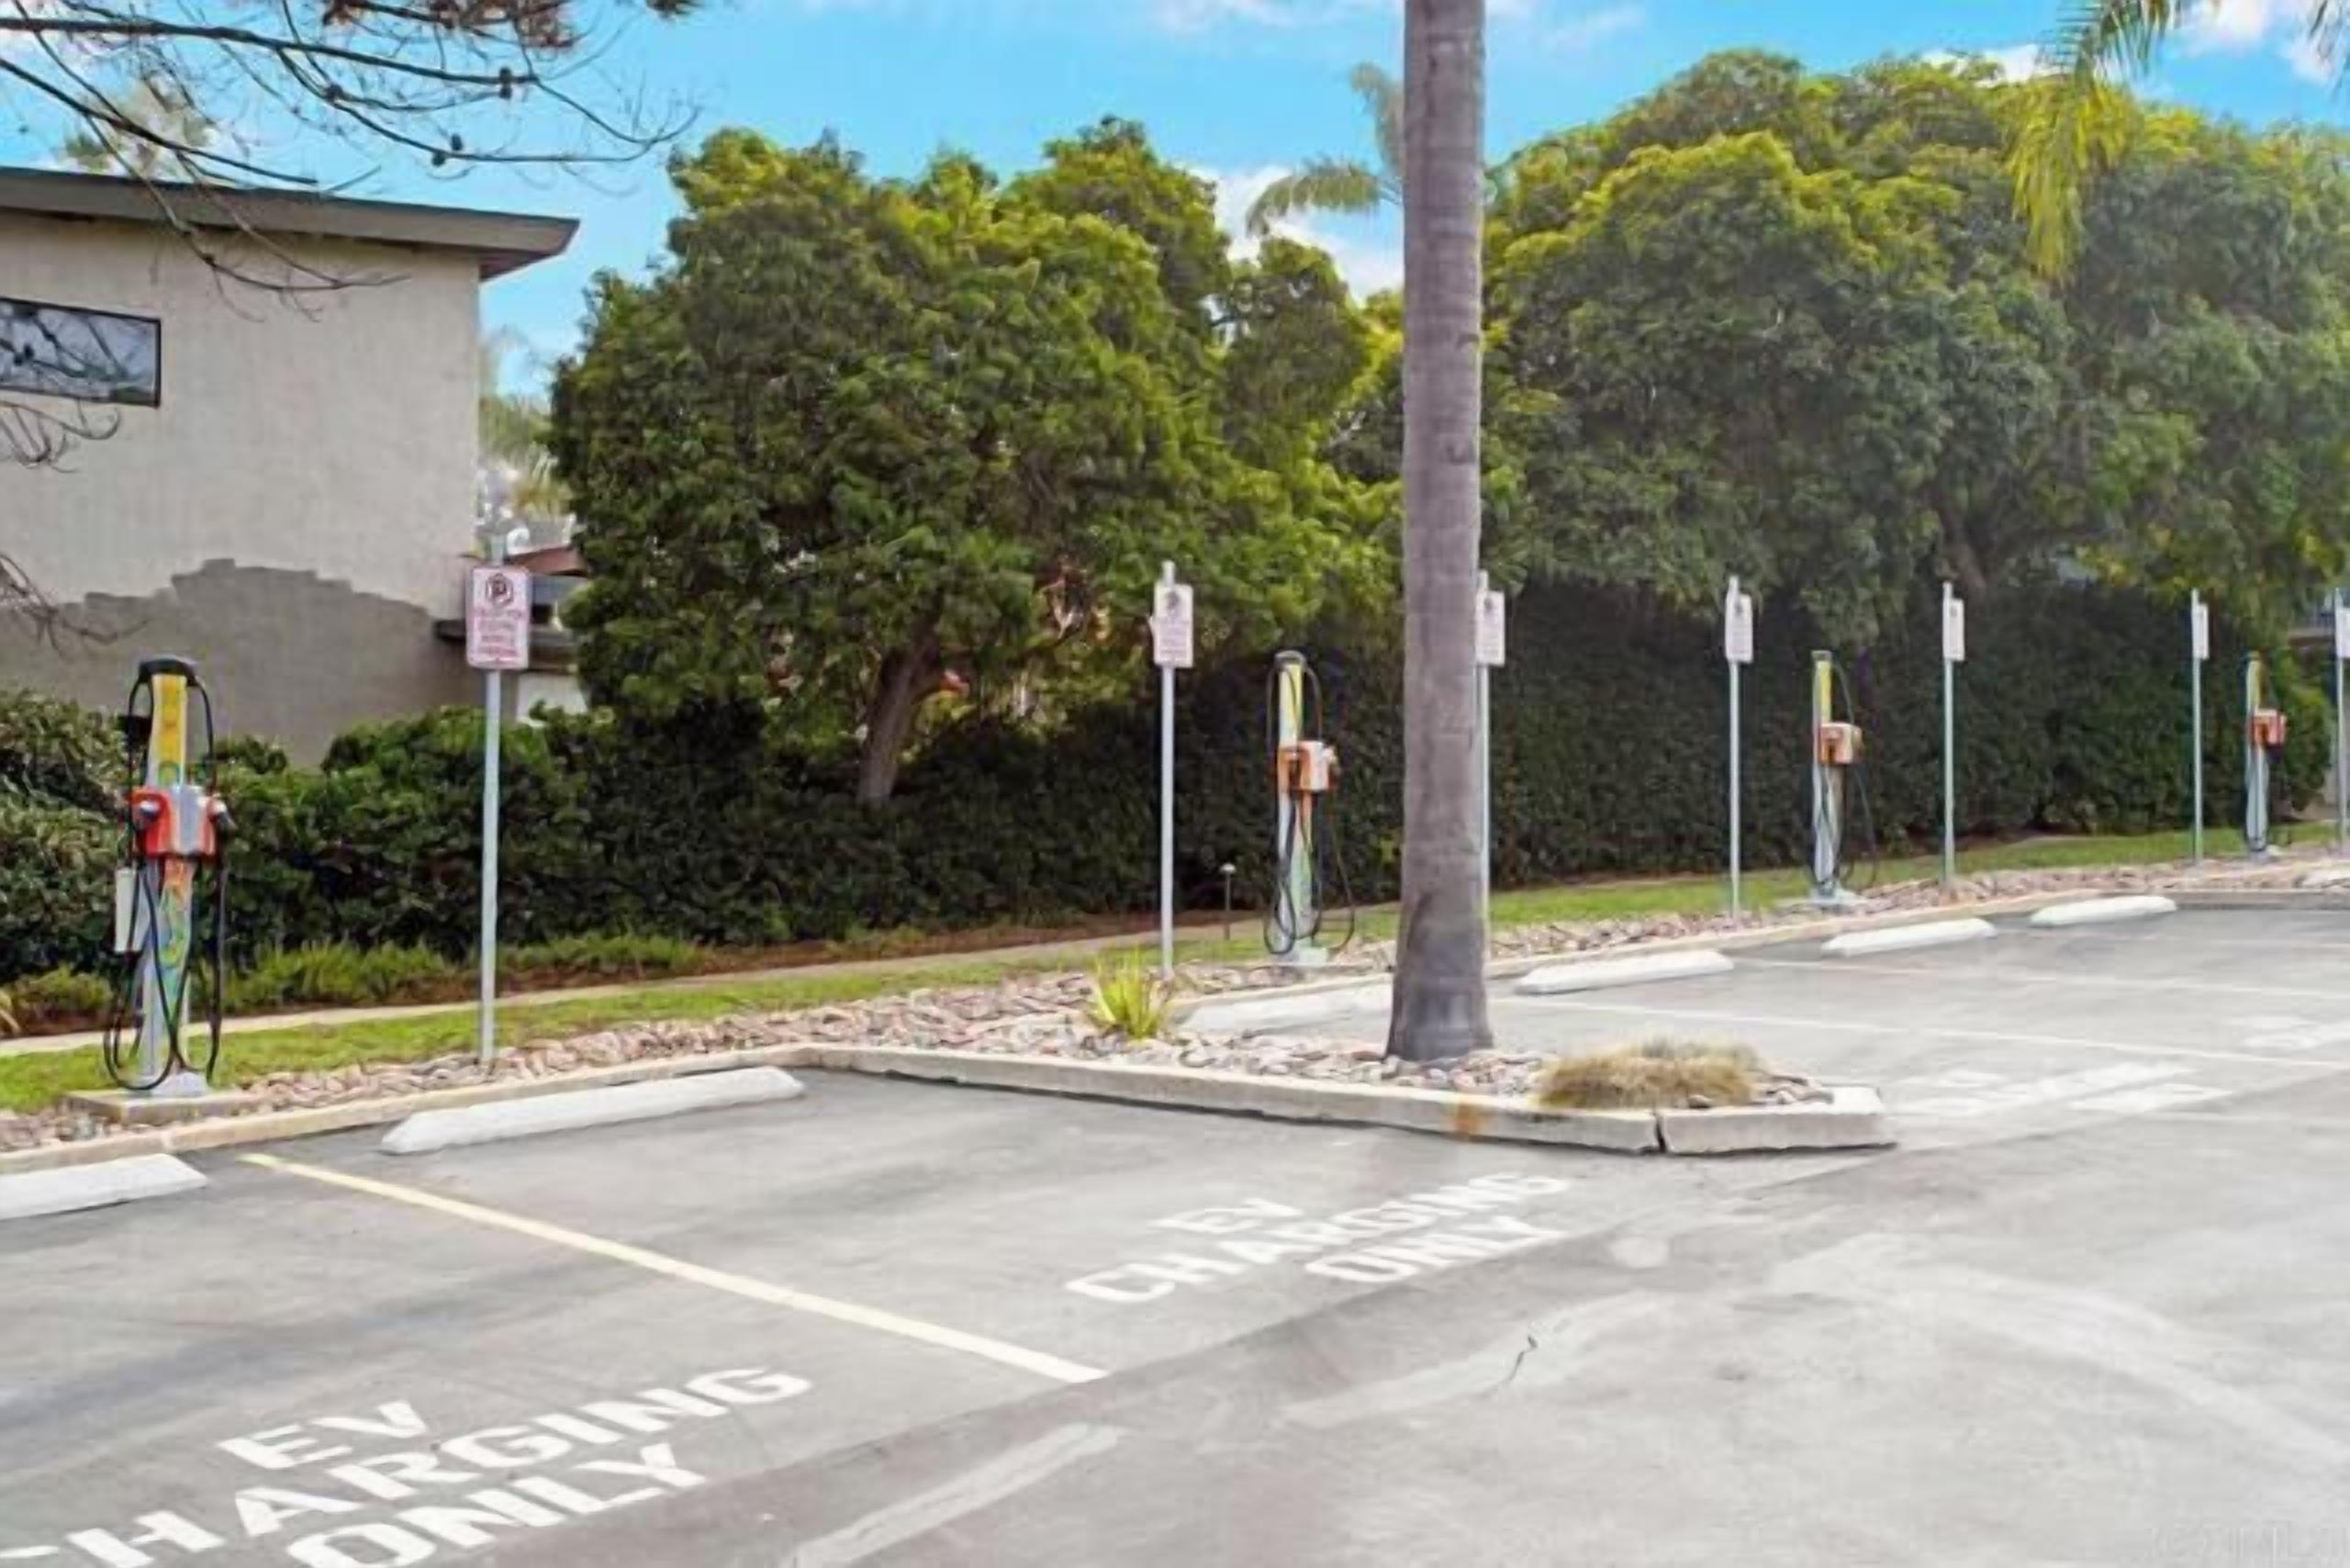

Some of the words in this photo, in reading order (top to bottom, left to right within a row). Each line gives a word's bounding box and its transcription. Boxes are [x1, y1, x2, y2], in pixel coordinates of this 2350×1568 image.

[1065, 1172, 1571, 1303] CHARGING
[1147, 1197, 1304, 1234] EV
[1304, 1215, 1568, 1283] ONLY
[0, 1368, 812, 1568] HARGING
[216, 1400, 427, 1470] EV
[286, 1442, 707, 1568] ONLY
